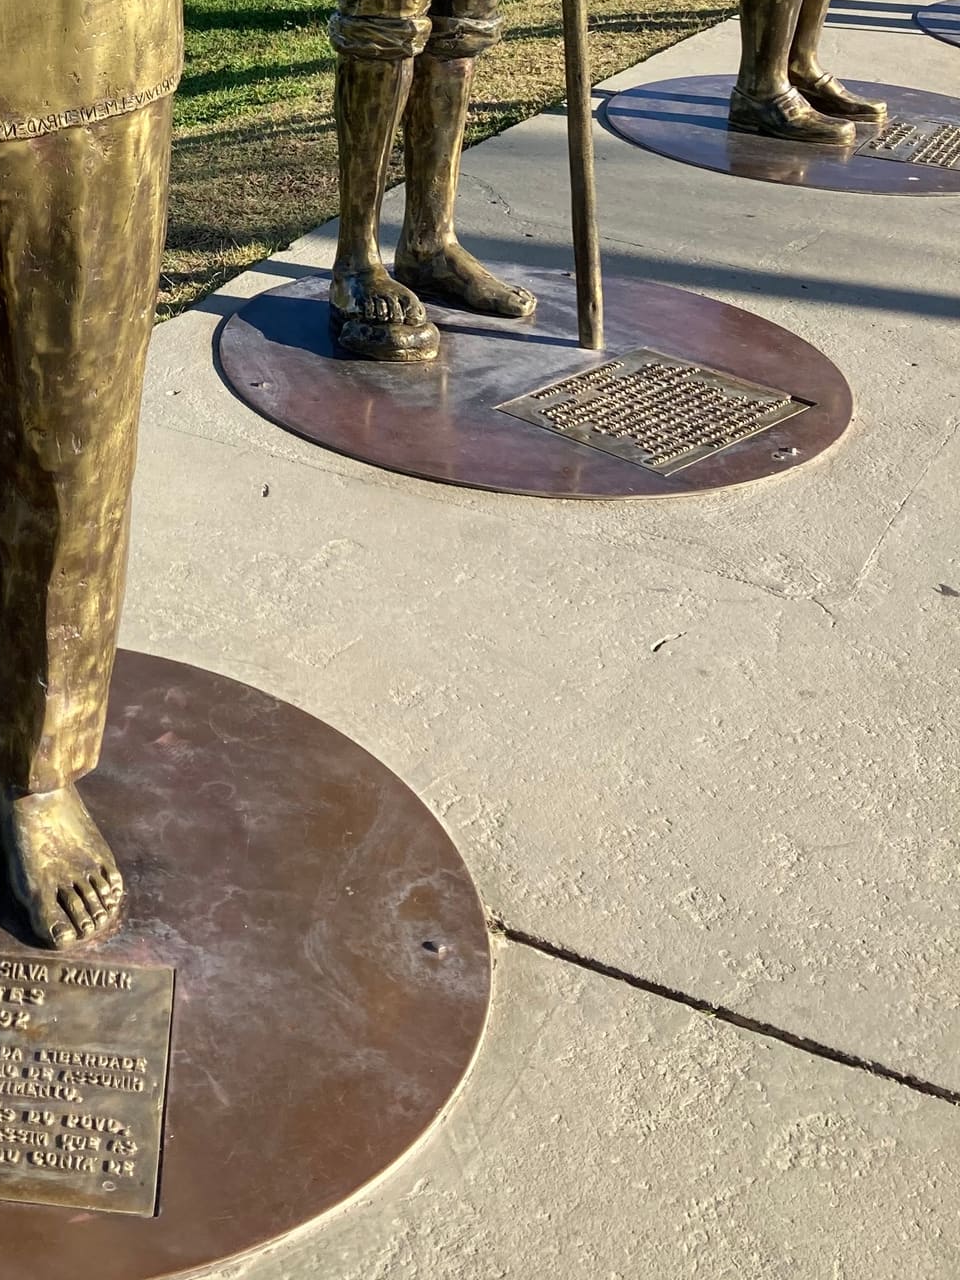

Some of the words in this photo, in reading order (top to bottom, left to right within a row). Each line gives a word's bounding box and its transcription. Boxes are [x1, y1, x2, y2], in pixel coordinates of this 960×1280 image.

[60, 967, 132, 990] XAVIER
[35, 1050, 148, 1073] LIBERDADE
[22, 1066, 55, 1083] DE
[59, 1070, 145, 1093] ASSUMIR
[22, 1111, 56, 1128] DO
[56, 1133, 101, 1153] QUE
[107, 1139, 139, 1156] AS
[102, 1160, 136, 1177] DE
